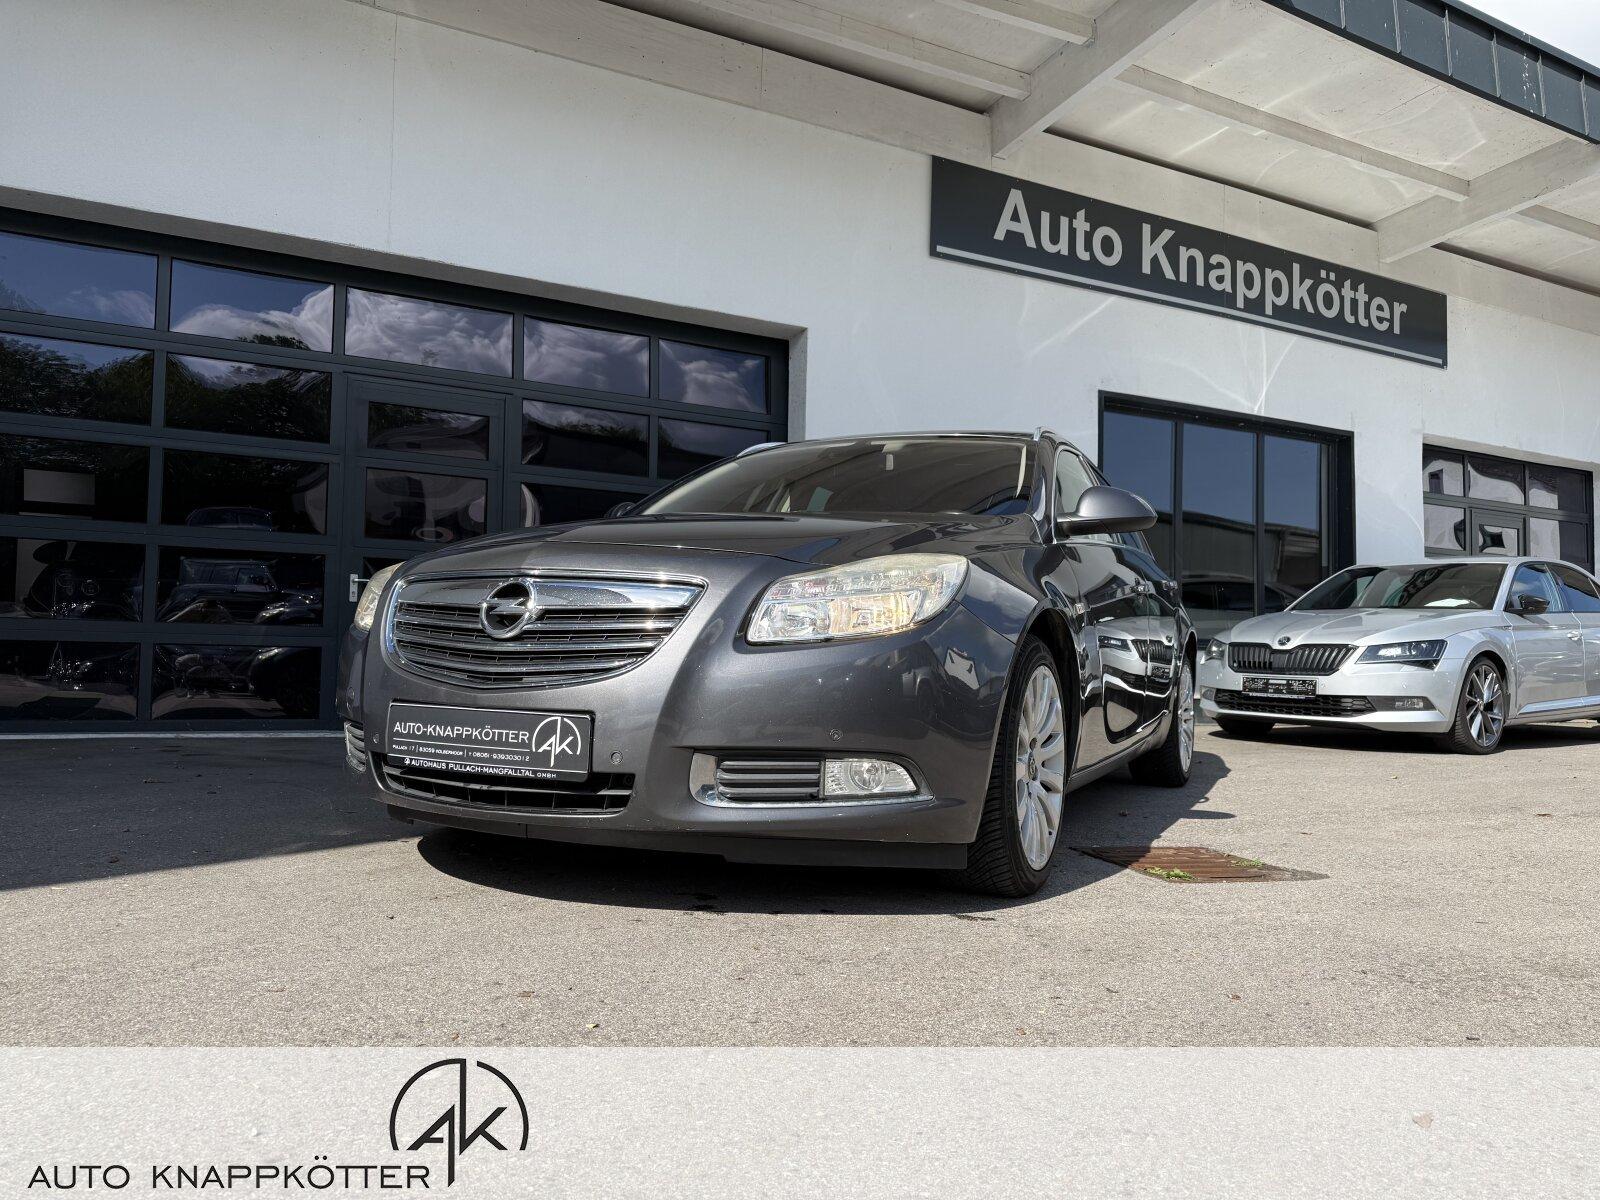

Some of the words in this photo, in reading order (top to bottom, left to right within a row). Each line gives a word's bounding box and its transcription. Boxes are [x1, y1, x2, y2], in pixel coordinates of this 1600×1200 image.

[993, 188, 1123, 267] Auto
[1141, 222, 1408, 335] Knappkötter
[393, 721, 530, 744] AUTO-KNAPPKÖTTER
[411, 759, 447, 769] AUTOHAUS
[448, 763, 535, 777] PULLACH-MANGFALLTAL
